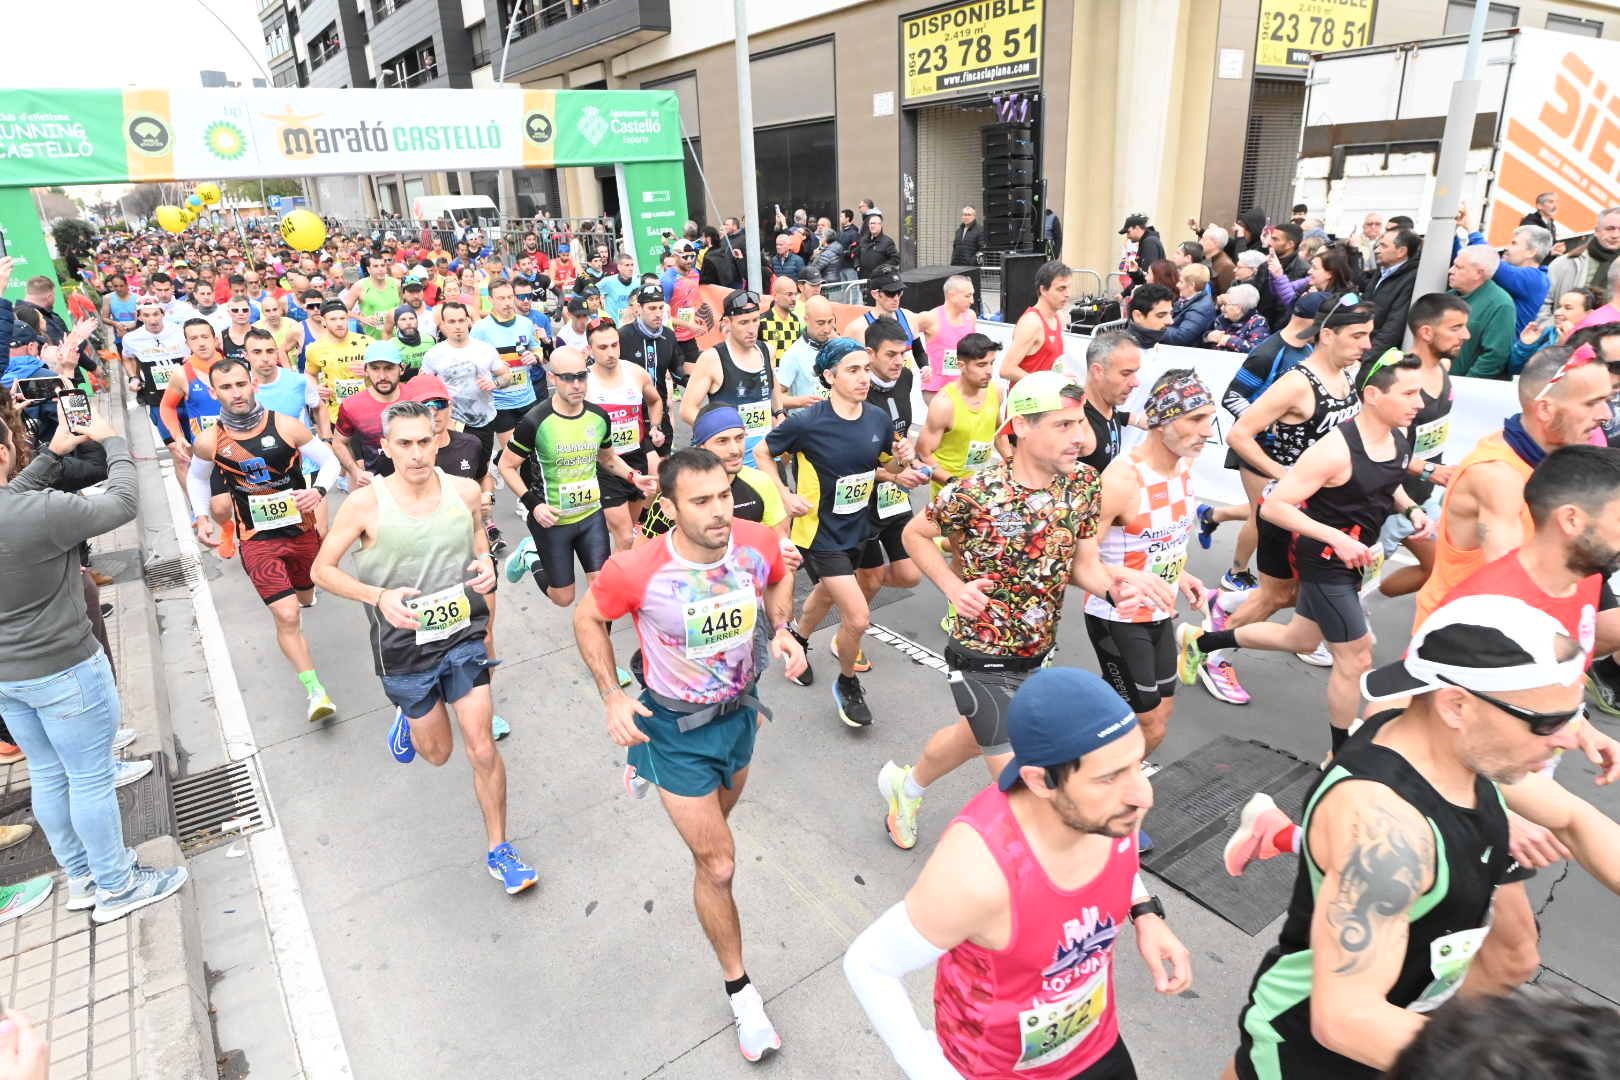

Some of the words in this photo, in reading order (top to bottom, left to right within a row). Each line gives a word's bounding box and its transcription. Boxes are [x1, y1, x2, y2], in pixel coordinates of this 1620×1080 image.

[909, 0, 1035, 39] DISPONIBLE
[1271, 11, 1300, 43] 23
[1310, 16, 1335, 46] 78
[1343, 21, 1367, 48] 51
[917, 44, 948, 75] 23
[958, 34, 992, 66] 78
[1003, 24, 1037, 58] 51
[610, 118, 661, 134] Castelló
[283, 120, 388, 155] marató
[392, 120, 503, 152] CASTELLÓ
[746, 409, 766, 425] 254
[612, 430, 633, 443] 242
[569, 488, 592, 504] 314
[845, 482, 868, 500] 262
[261, 501, 288, 517] 189
[424, 601, 459, 627] 236
[701, 608, 743, 636] 446
[705, 628, 740, 645] FERRER
[1042, 998, 1092, 1047] 372
